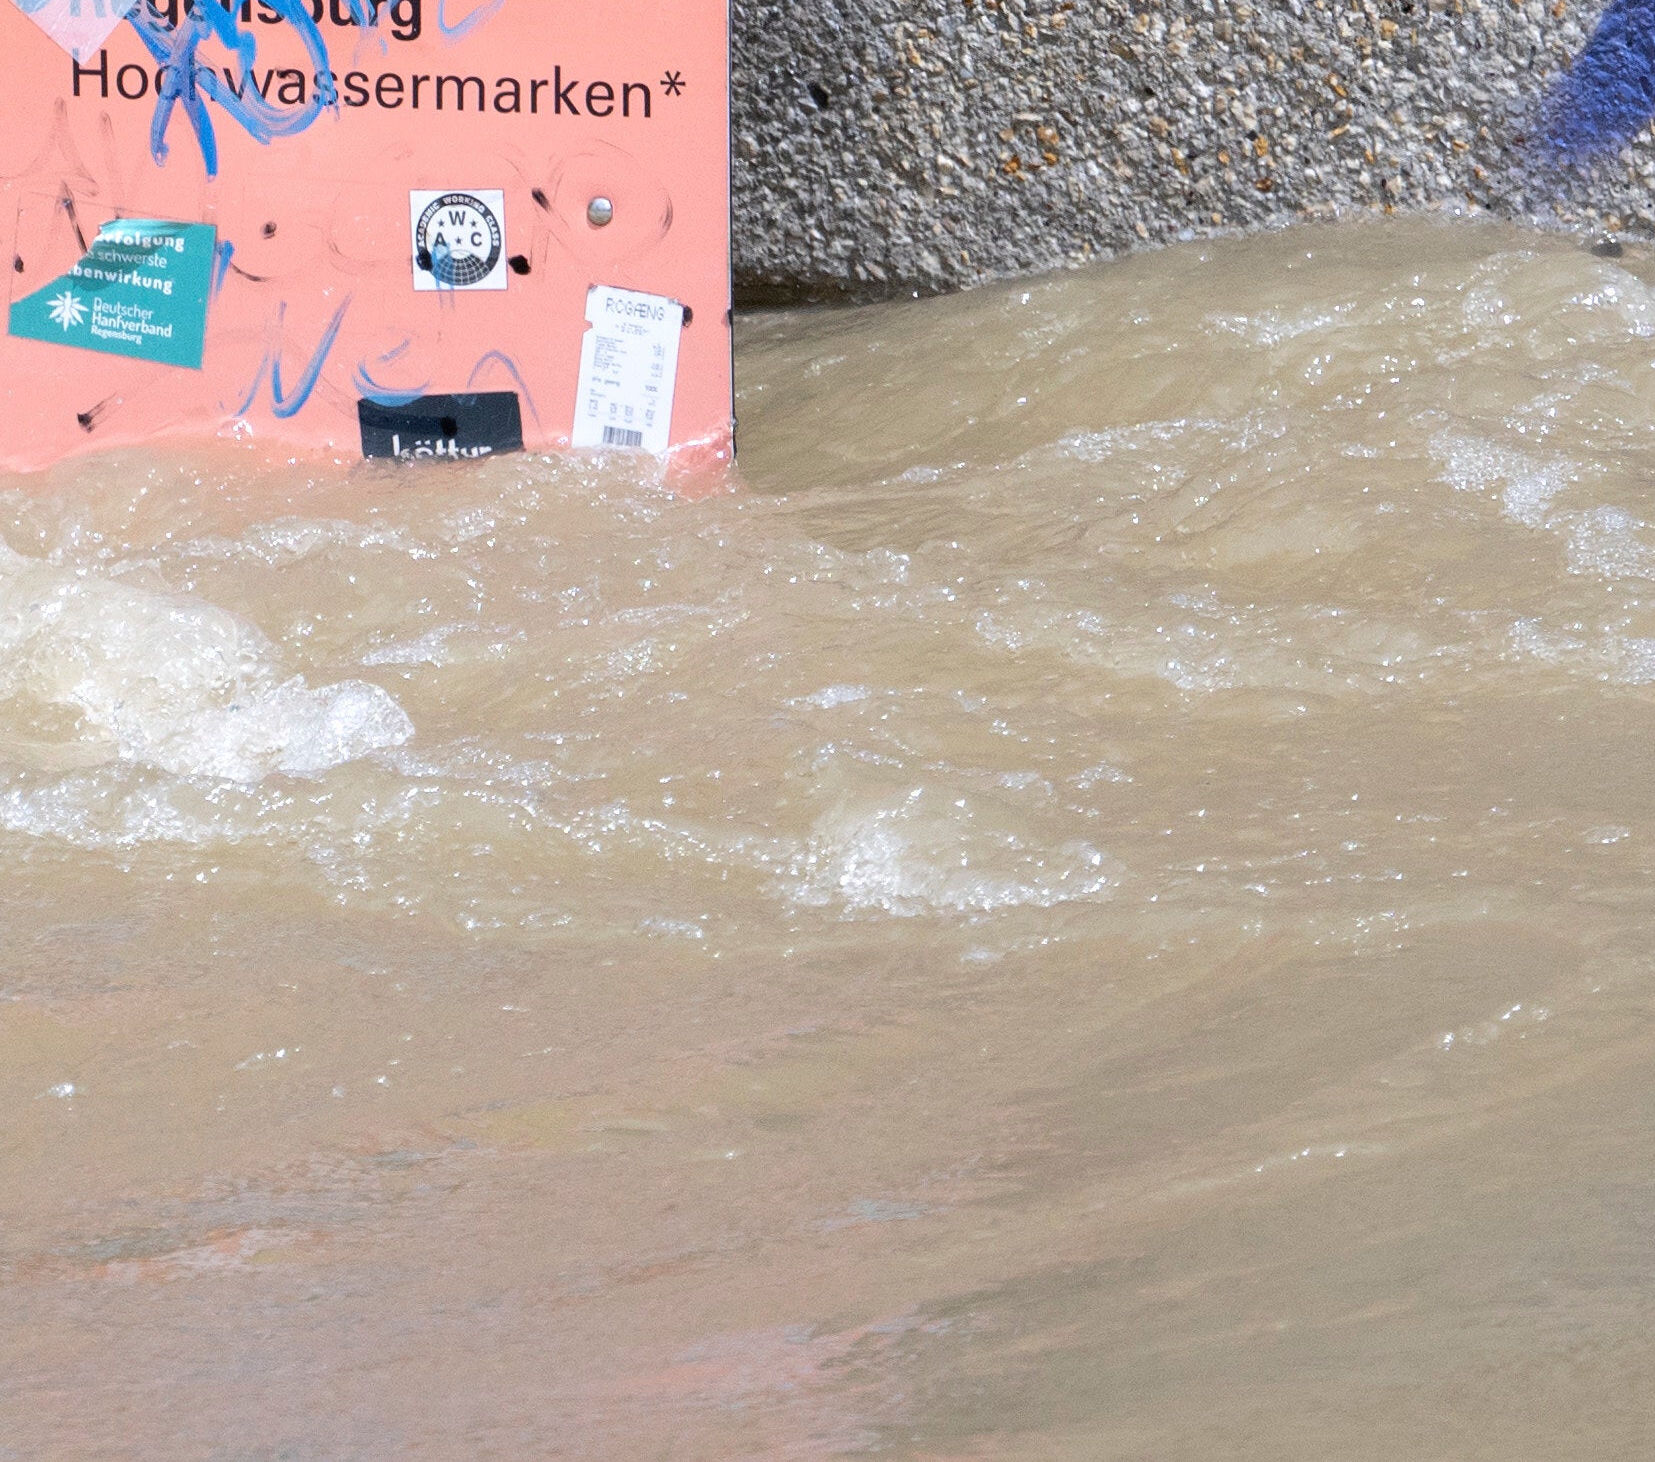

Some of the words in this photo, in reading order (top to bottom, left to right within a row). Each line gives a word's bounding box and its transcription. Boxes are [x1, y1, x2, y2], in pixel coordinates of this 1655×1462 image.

[442, 195, 486, 214] WORKING
[485, 215, 500, 247] CLASS
[99, 250, 168, 268] schwerste
[93, 297, 153, 319] Deutscher
[91, 325, 143, 344] Regensburg
[92, 312, 173, 338] Hanfverband
